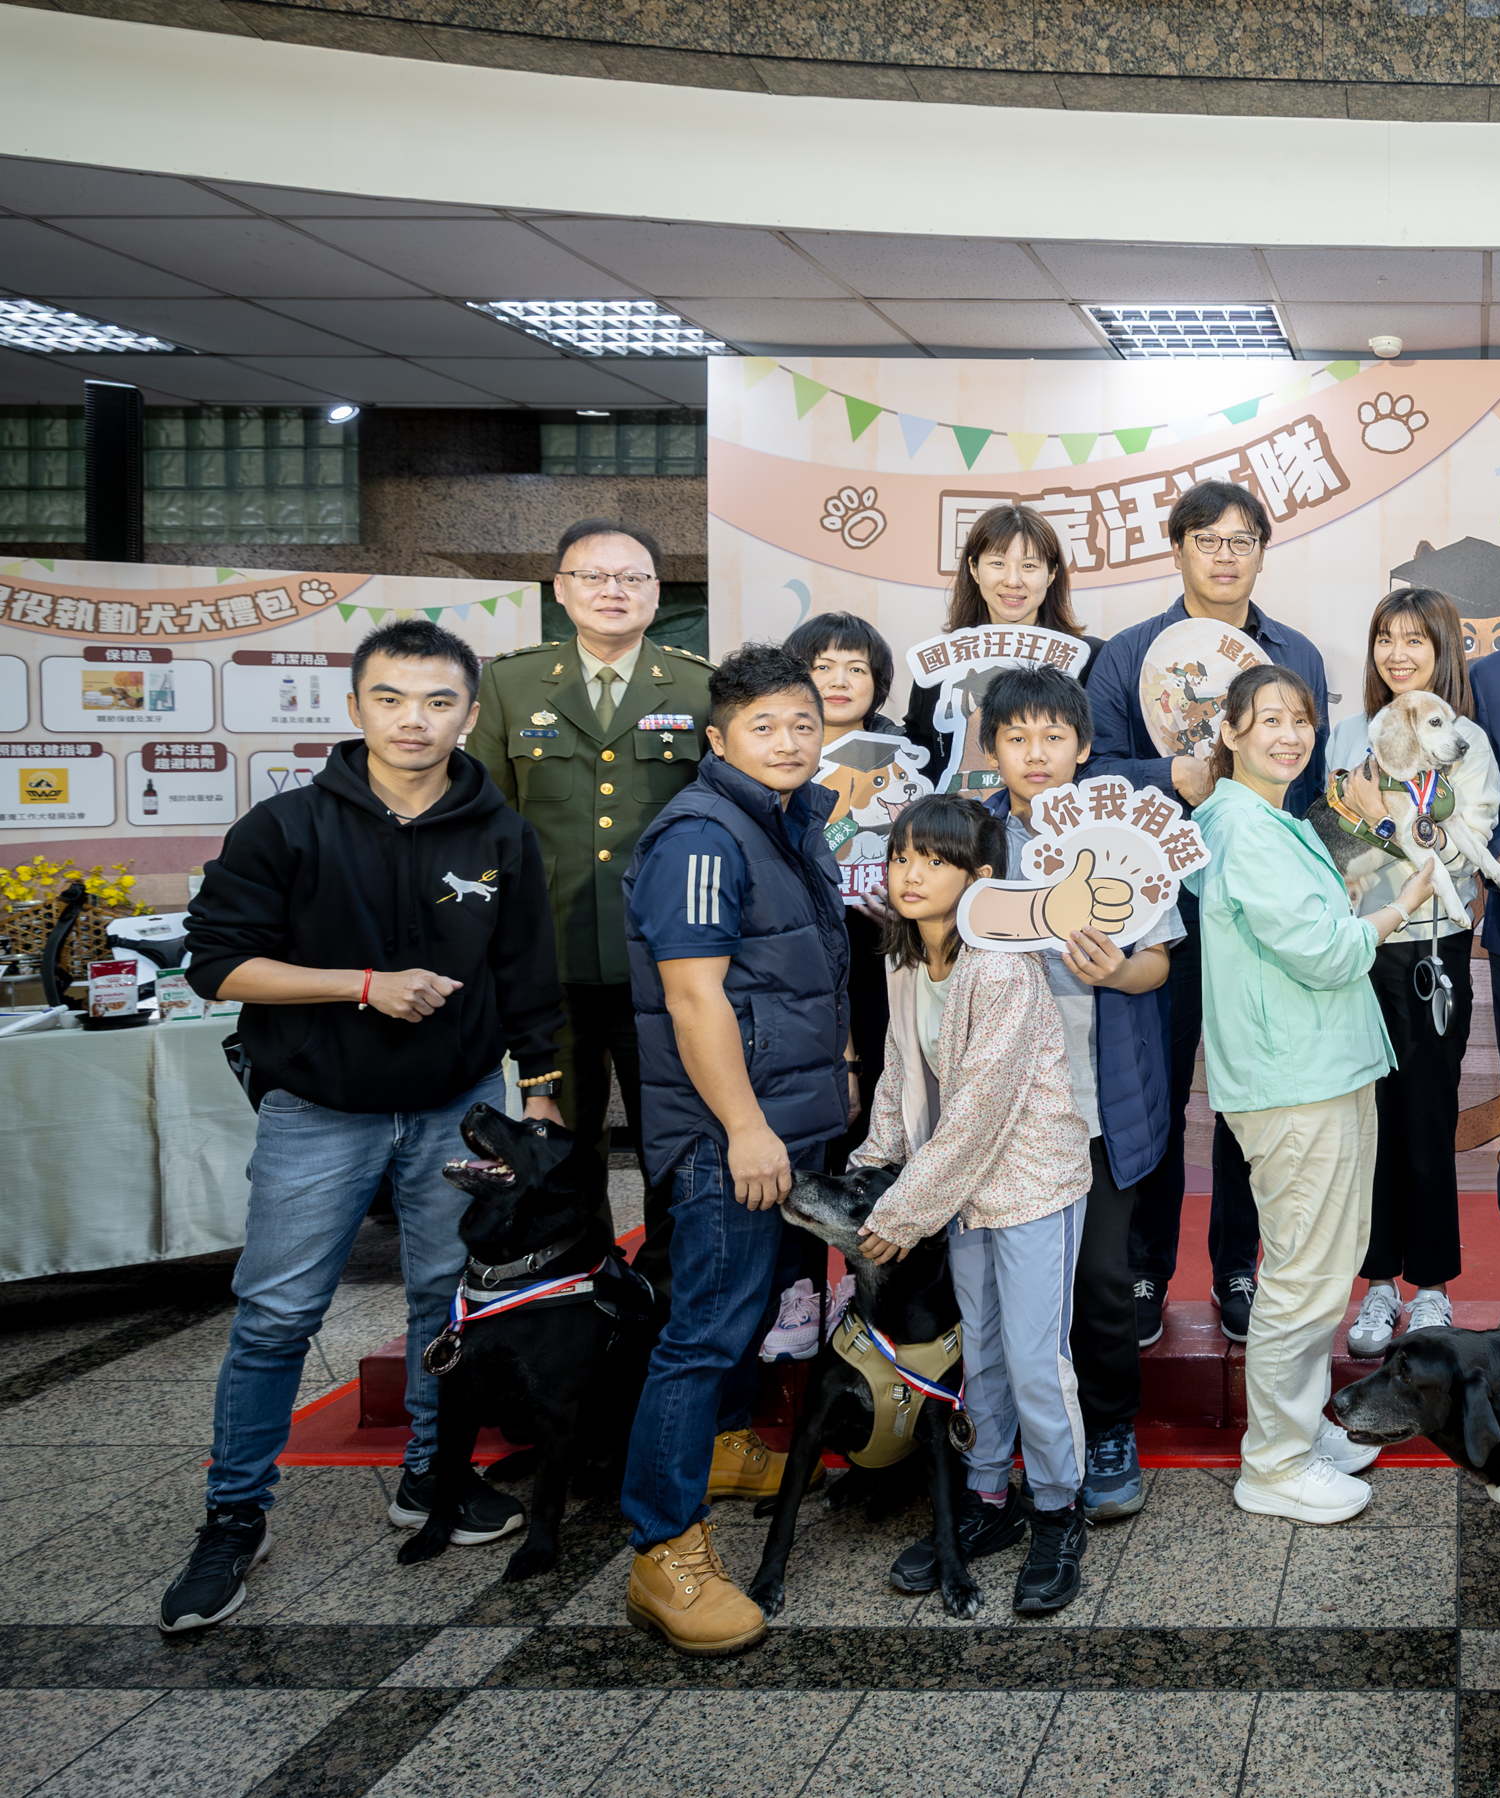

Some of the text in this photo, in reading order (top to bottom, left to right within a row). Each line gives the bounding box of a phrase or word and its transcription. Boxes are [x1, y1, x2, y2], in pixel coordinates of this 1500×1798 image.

[105, 649, 152, 662] 保健品
[271, 653, 328, 666] 清潔用品
[916, 631, 1080, 675] 國家汪汪隊
[826, 820, 845, 841] PHIA
[1042, 783, 1205, 872] 你我相挺
